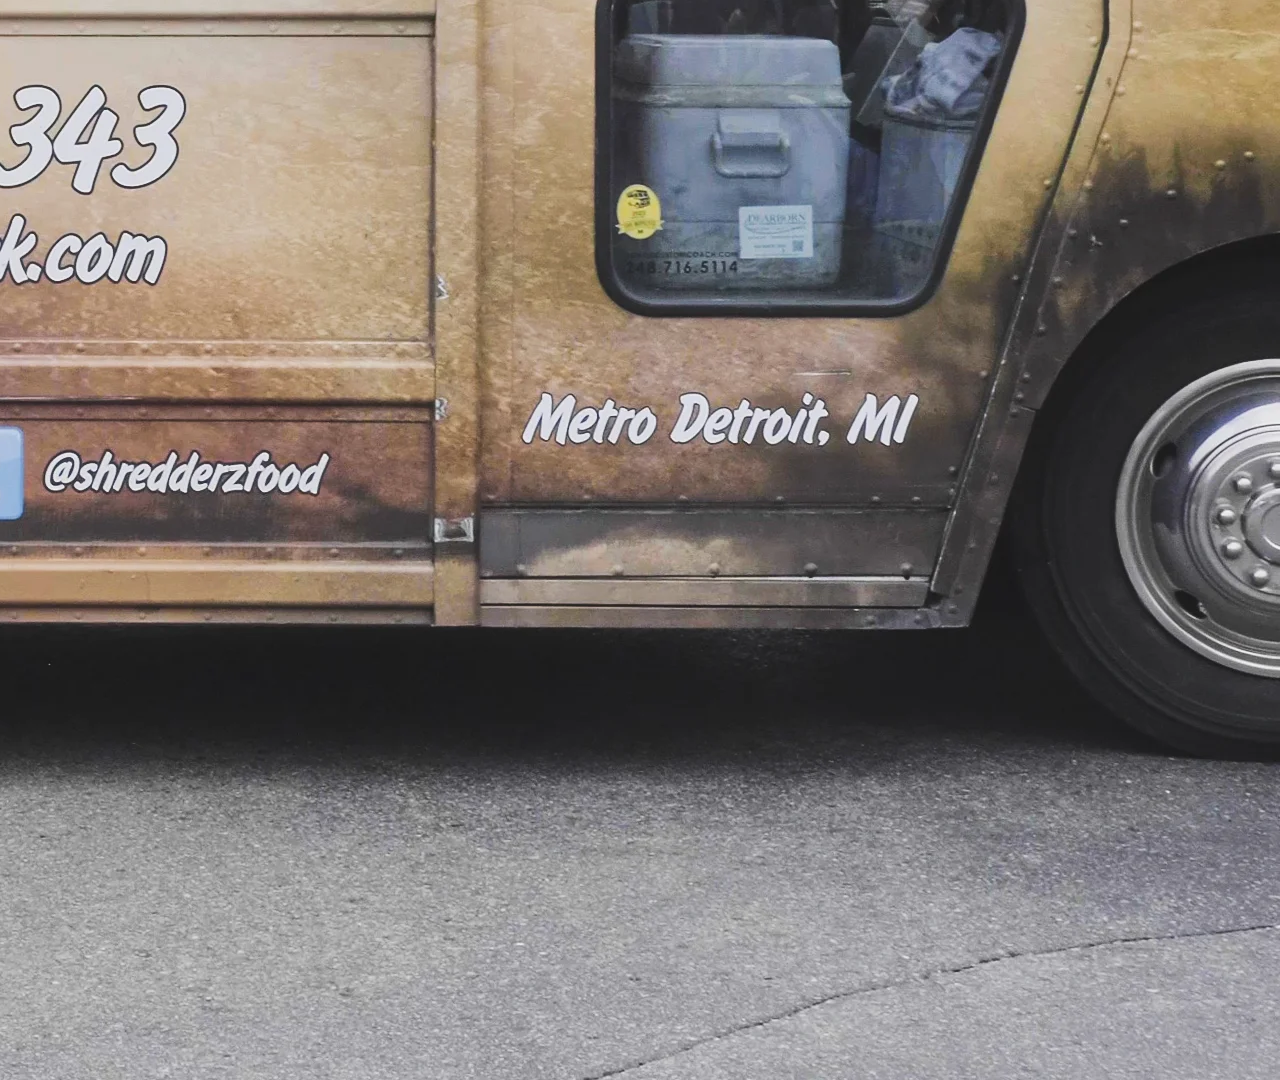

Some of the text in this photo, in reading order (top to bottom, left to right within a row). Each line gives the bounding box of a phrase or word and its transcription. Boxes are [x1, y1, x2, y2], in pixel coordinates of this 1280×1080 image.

[522, 393, 920, 446] Metro Detroit, MI
[43, 449, 330, 496] @shredderzfood
